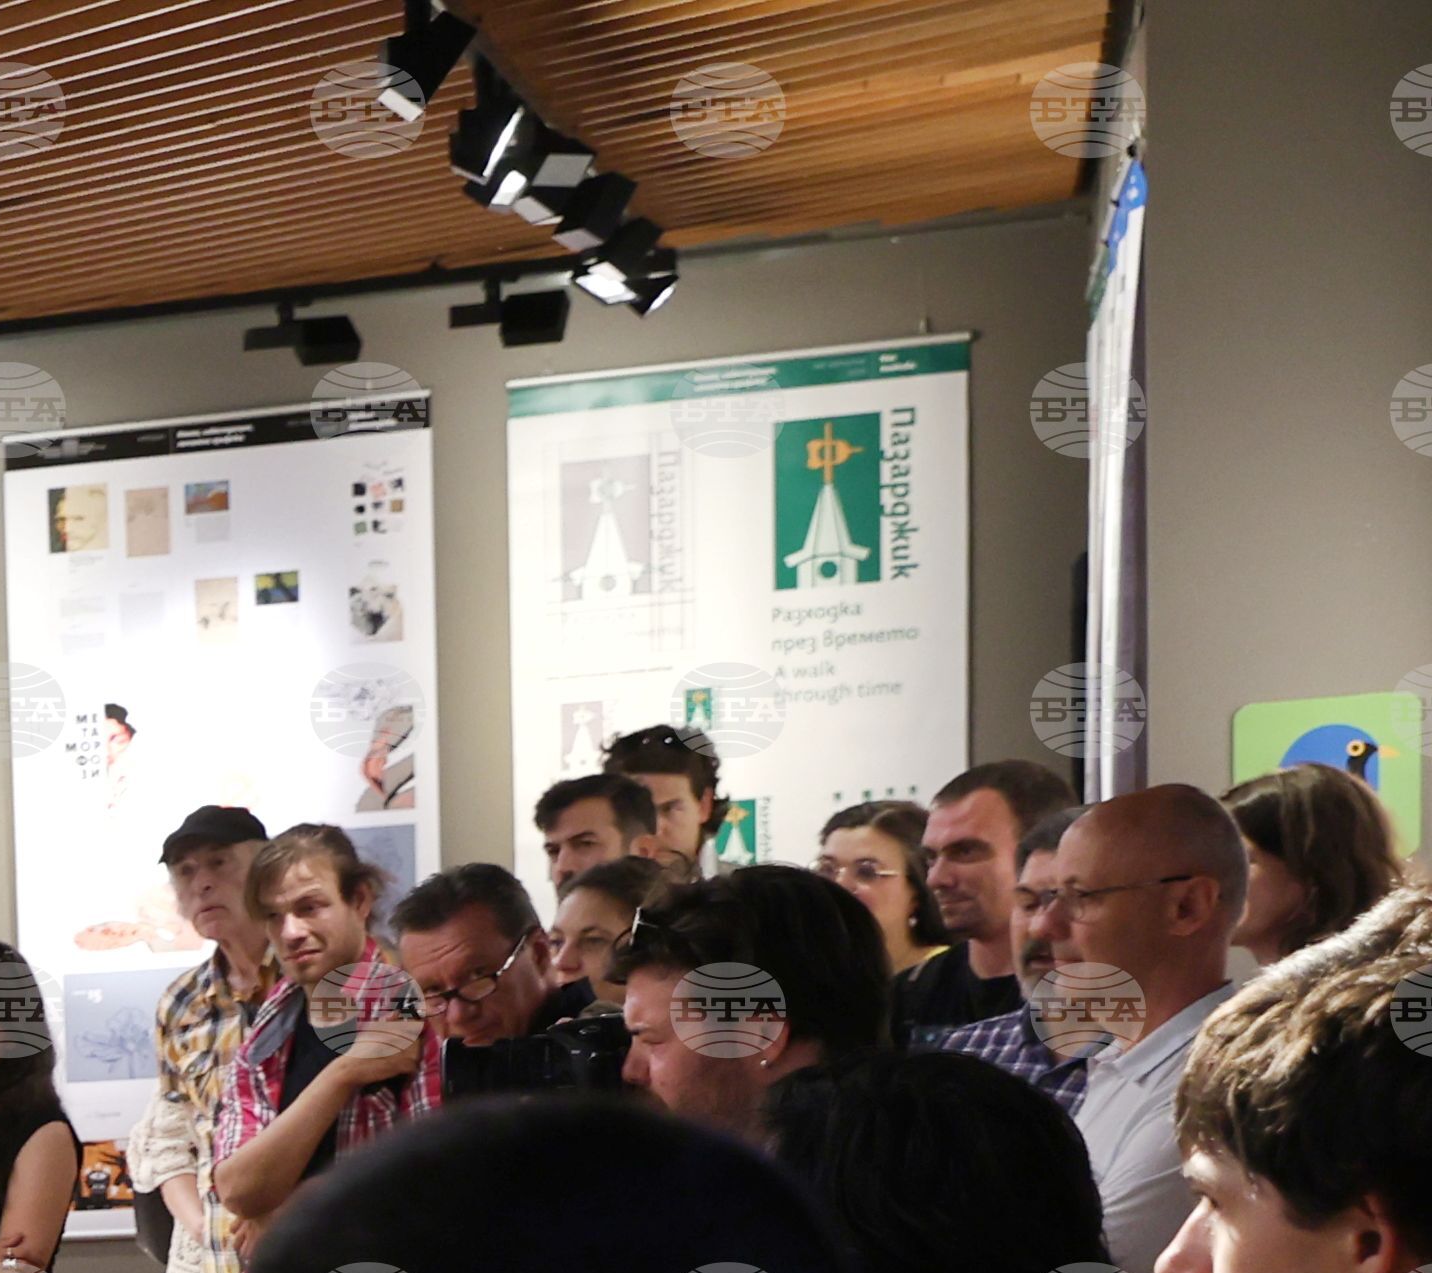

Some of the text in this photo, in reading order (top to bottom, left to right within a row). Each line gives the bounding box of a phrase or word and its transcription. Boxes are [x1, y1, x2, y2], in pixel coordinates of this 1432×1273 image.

[879, 406, 920, 581] Пазарджик
[771, 601, 862, 627] Разходка
[771, 624, 920, 657] през времето
[793, 660, 835, 679] walk
[857, 680, 902, 699] time
